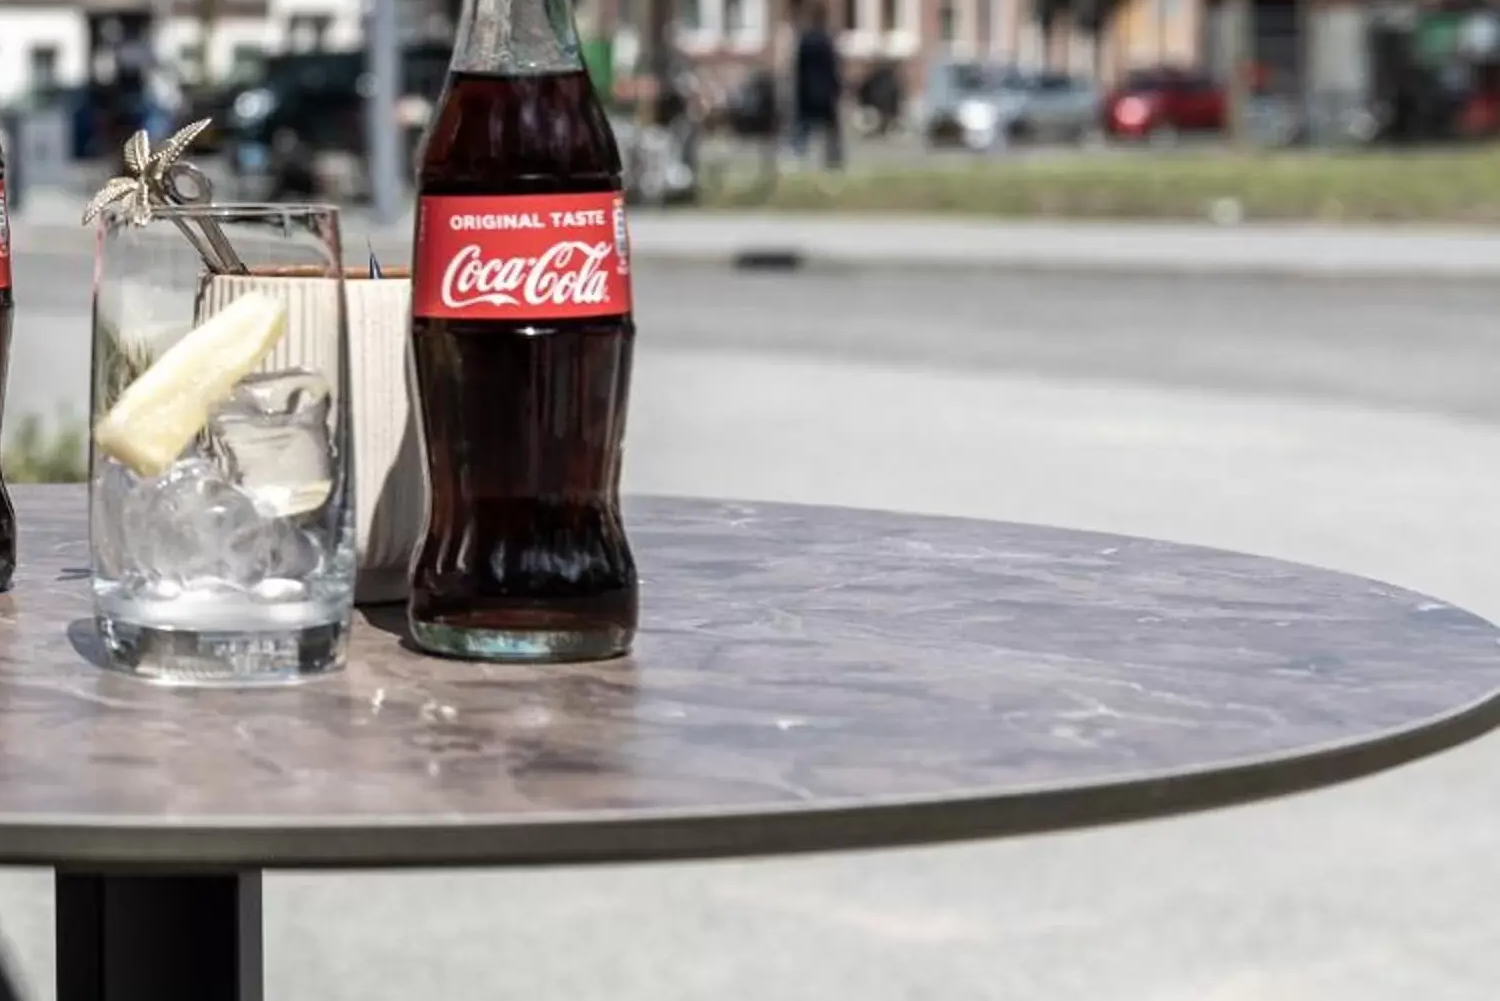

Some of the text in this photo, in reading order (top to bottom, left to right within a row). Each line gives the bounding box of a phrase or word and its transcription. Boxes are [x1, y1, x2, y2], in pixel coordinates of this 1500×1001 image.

[449, 210, 606, 230] ORIGINAL TASTE
[441, 241, 612, 308] Coca-Cola
